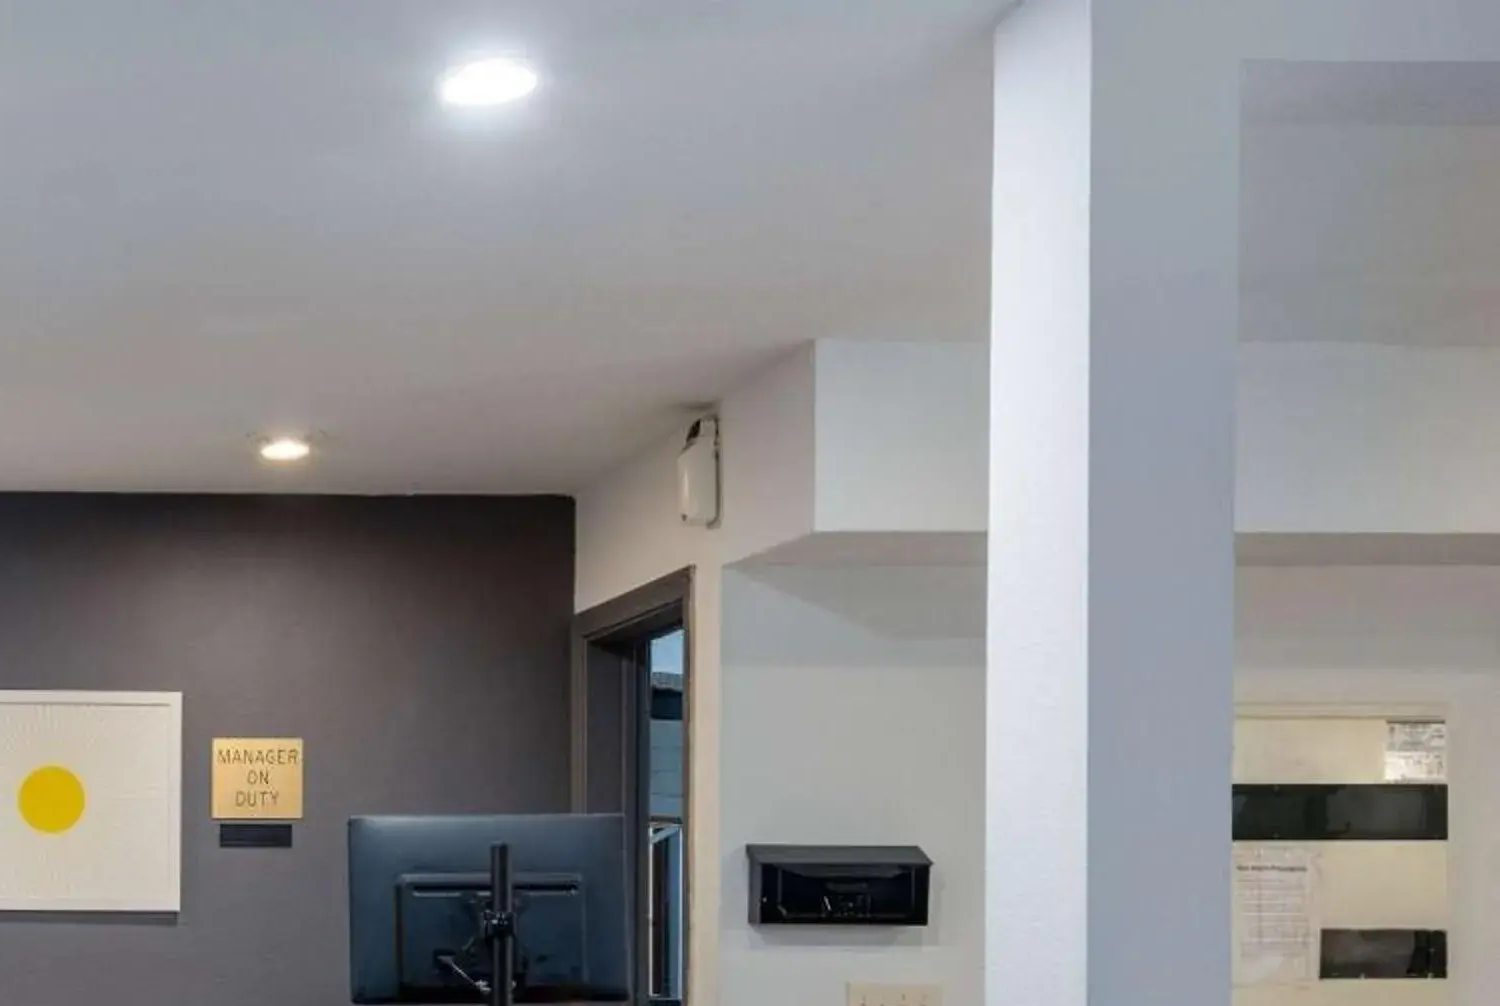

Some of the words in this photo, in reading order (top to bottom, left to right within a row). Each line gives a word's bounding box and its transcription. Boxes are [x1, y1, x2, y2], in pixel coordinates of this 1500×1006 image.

[217, 748, 299, 765] MANAGER
[247, 769, 269, 785] ON
[234, 790, 280, 807] DUTY
